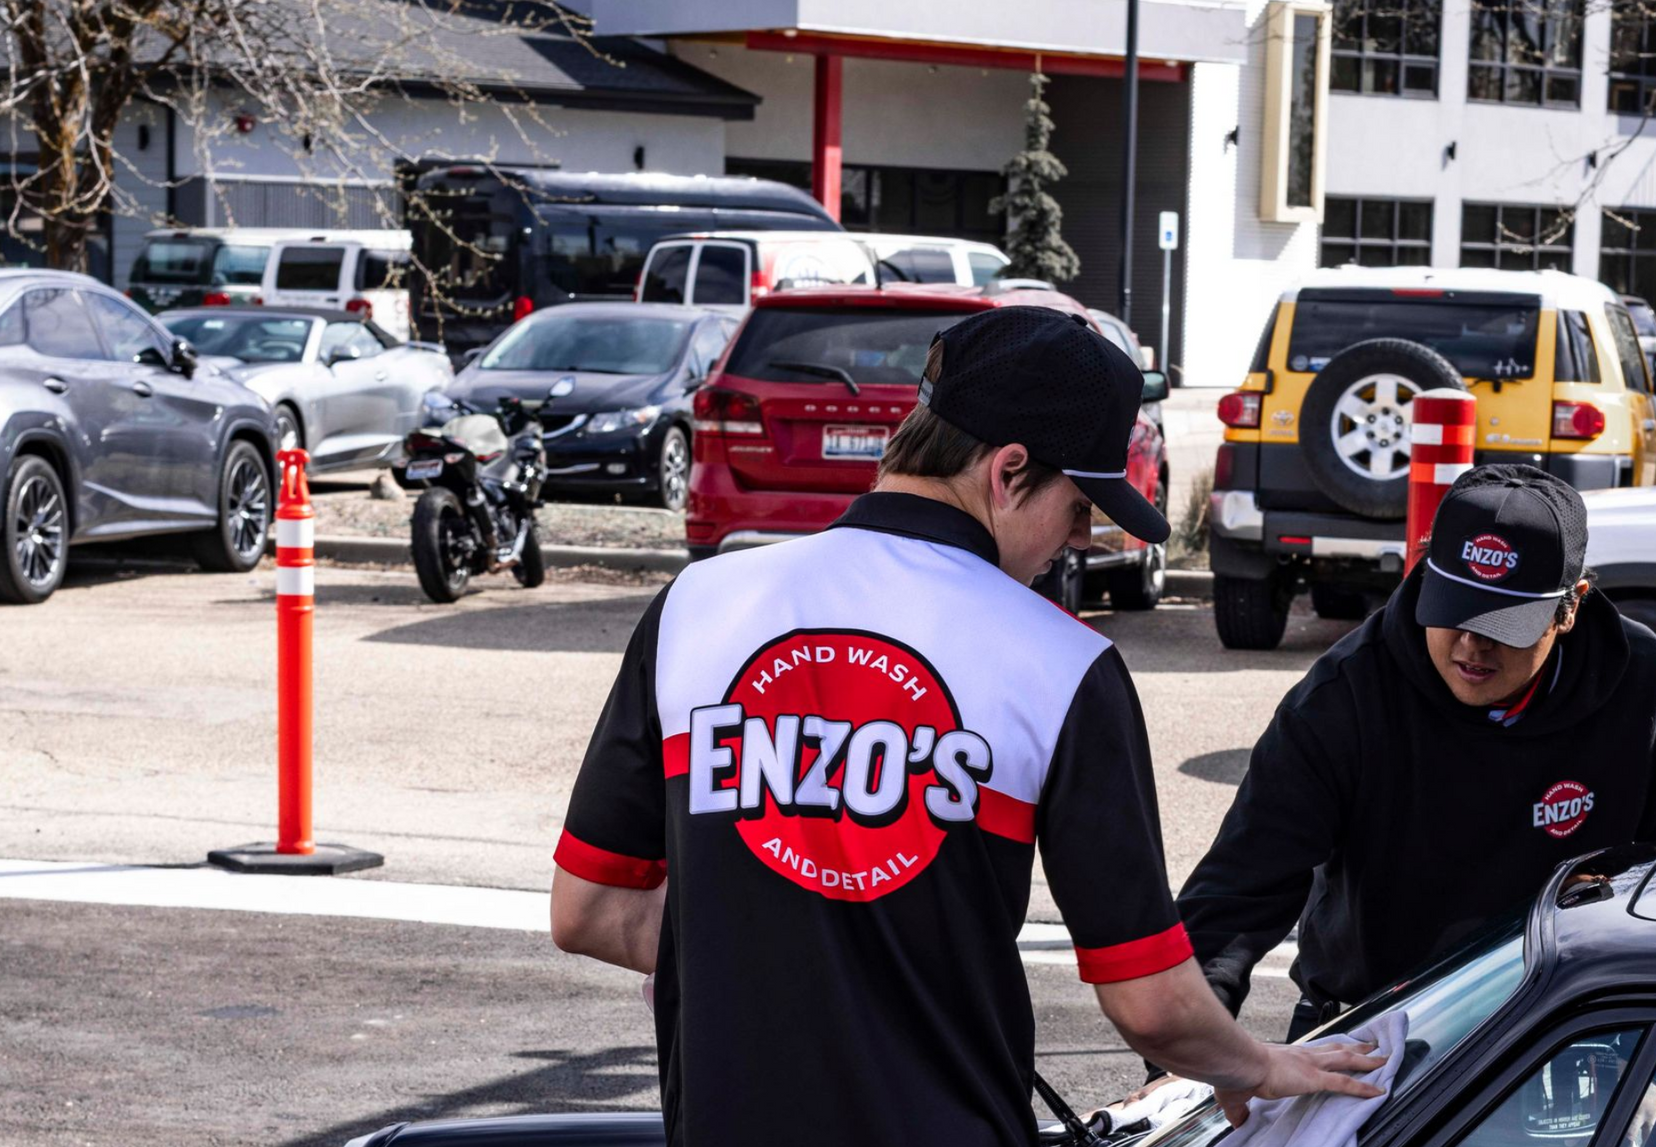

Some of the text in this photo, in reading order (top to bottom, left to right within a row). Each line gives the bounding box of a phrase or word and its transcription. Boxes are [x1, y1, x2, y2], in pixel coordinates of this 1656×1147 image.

[1461, 540, 1519, 569] ENZO'S
[1476, 535, 1508, 549] HAND WASH
[1471, 566, 1482, 576] AND
[751, 645, 928, 702] HAND WASH
[689, 703, 992, 823] ENZO'S
[1544, 783, 1584, 801] HAND WASH
[1533, 791, 1595, 828] ENZO'S
[1550, 819, 1583, 836] AND DETAIL
[762, 836, 919, 891] AND DETAIL
